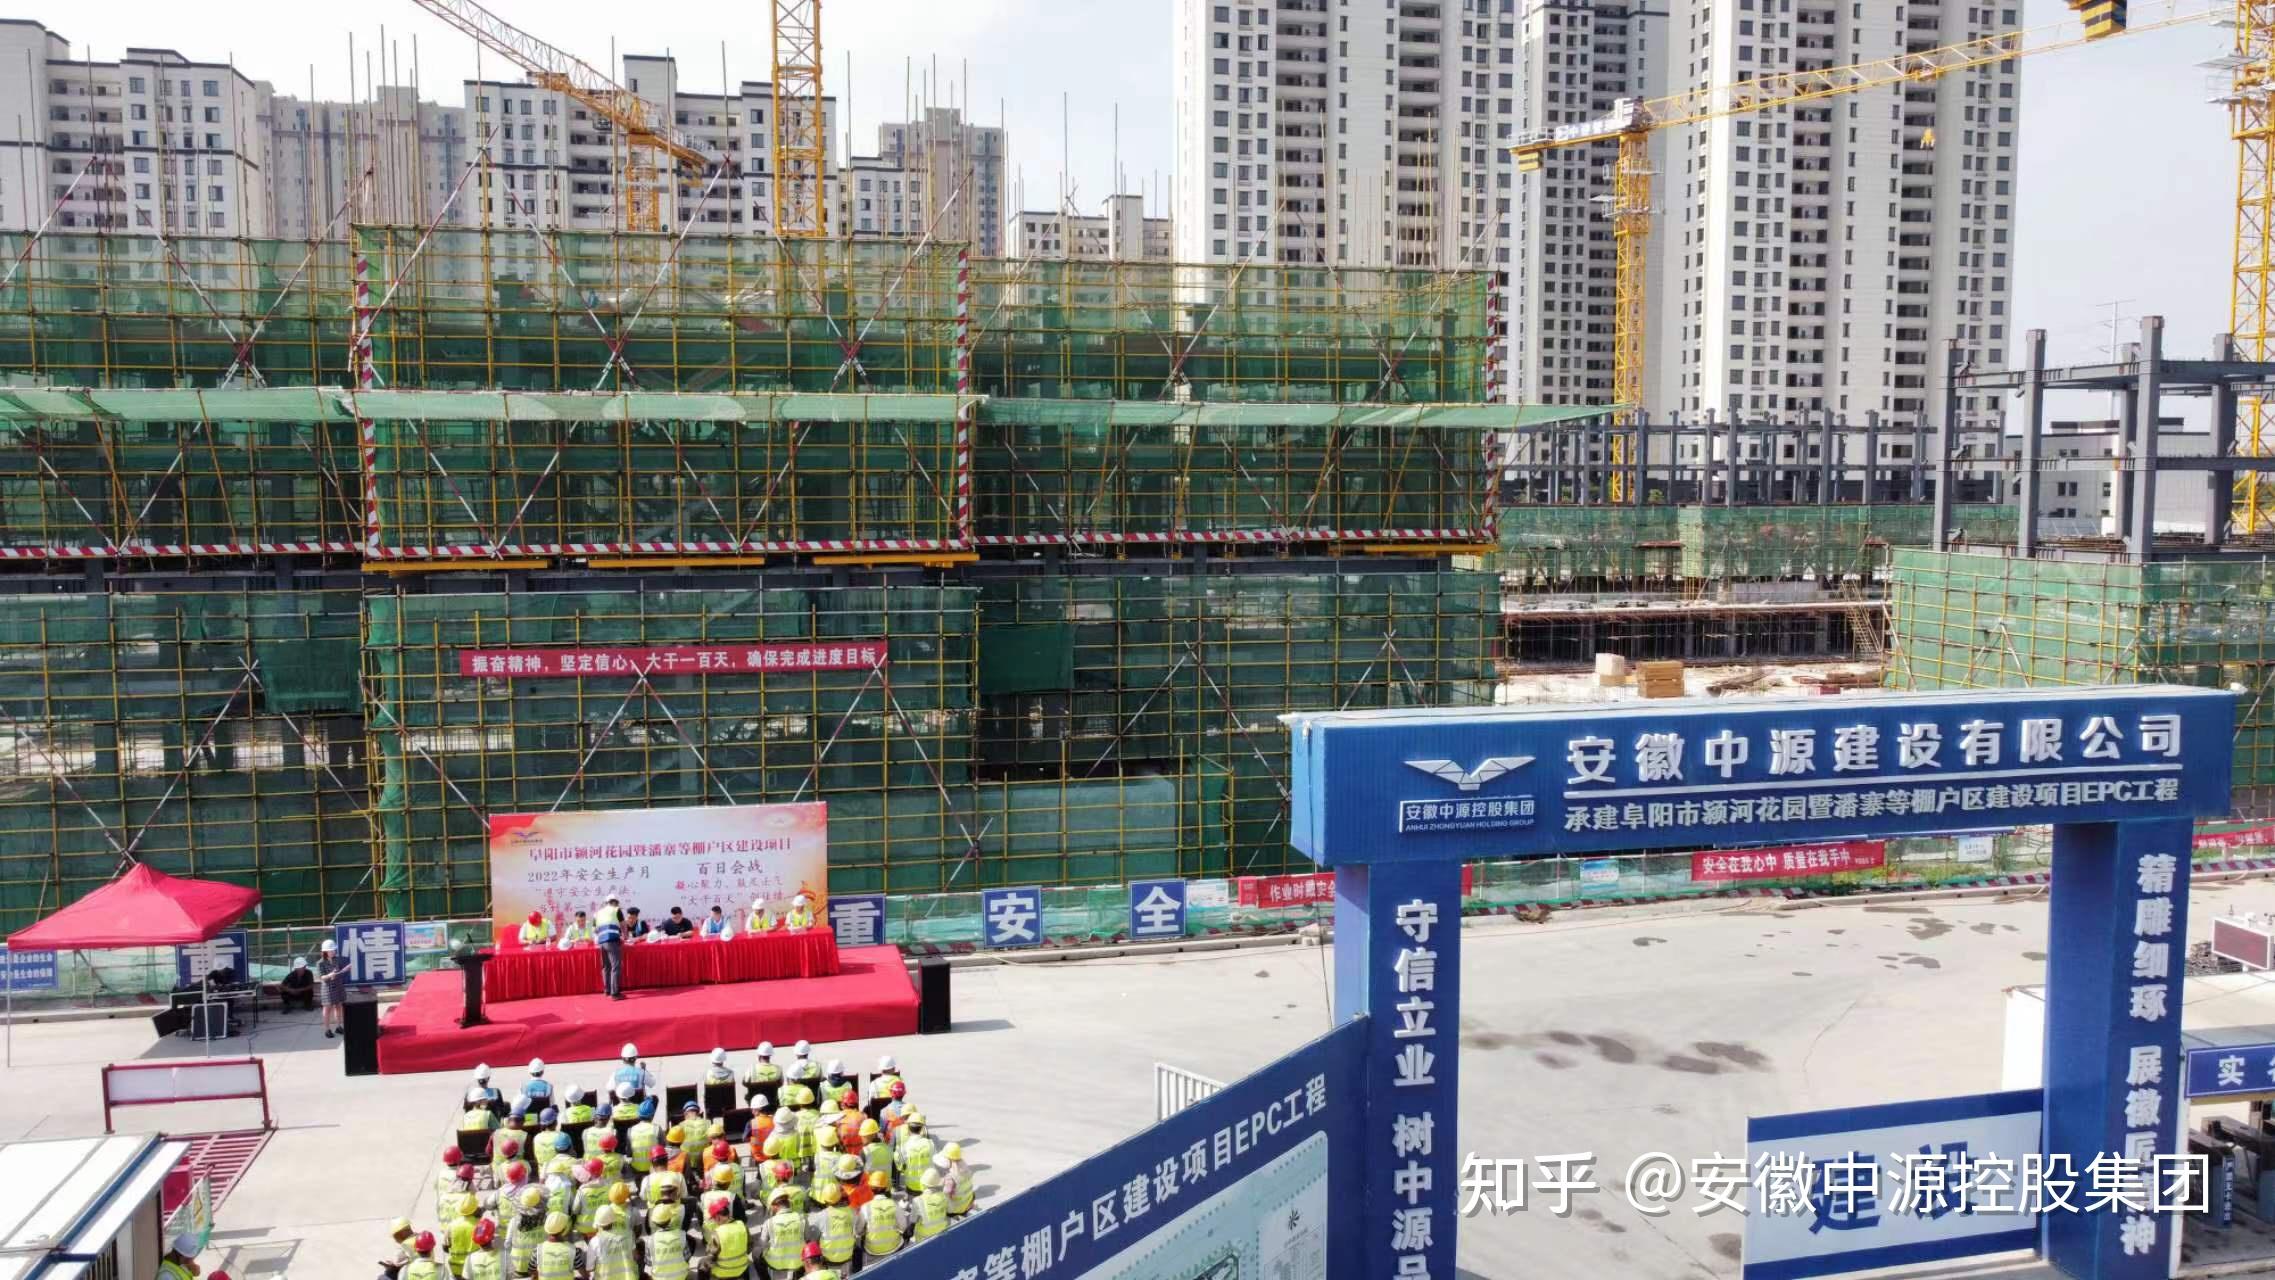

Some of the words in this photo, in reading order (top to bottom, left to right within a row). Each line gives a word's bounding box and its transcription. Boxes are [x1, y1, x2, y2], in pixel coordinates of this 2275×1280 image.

[1566, 714, 2182, 785] 安徽中源建设有限公司
[1405, 823, 1429, 832] ANHUI
[1429, 821, 1475, 831] ZHONGYUAN
[1476, 820, 1508, 828] HOLDING
[1509, 818, 1535, 826] GROUP
[1406, 800, 1535, 821] 安徽中源控股集团
[528, 865, 650, 883] 2022年安全生产月
[697, 859, 764, 876] 百日会战
[1703, 855, 1778, 875] 安全在我心中
[1783, 848, 1851, 871] 质量在我手中
[829, 900, 881, 945] 重
[987, 892, 1038, 944] 安
[1133, 886, 1181, 935] 全
[341, 926, 399, 981] 情
[2128, 853, 2177, 1023] 精雕细琢
[1392, 898, 1439, 1087] 守信立业
[1390, 1111, 1435, 1280] 树中源品
